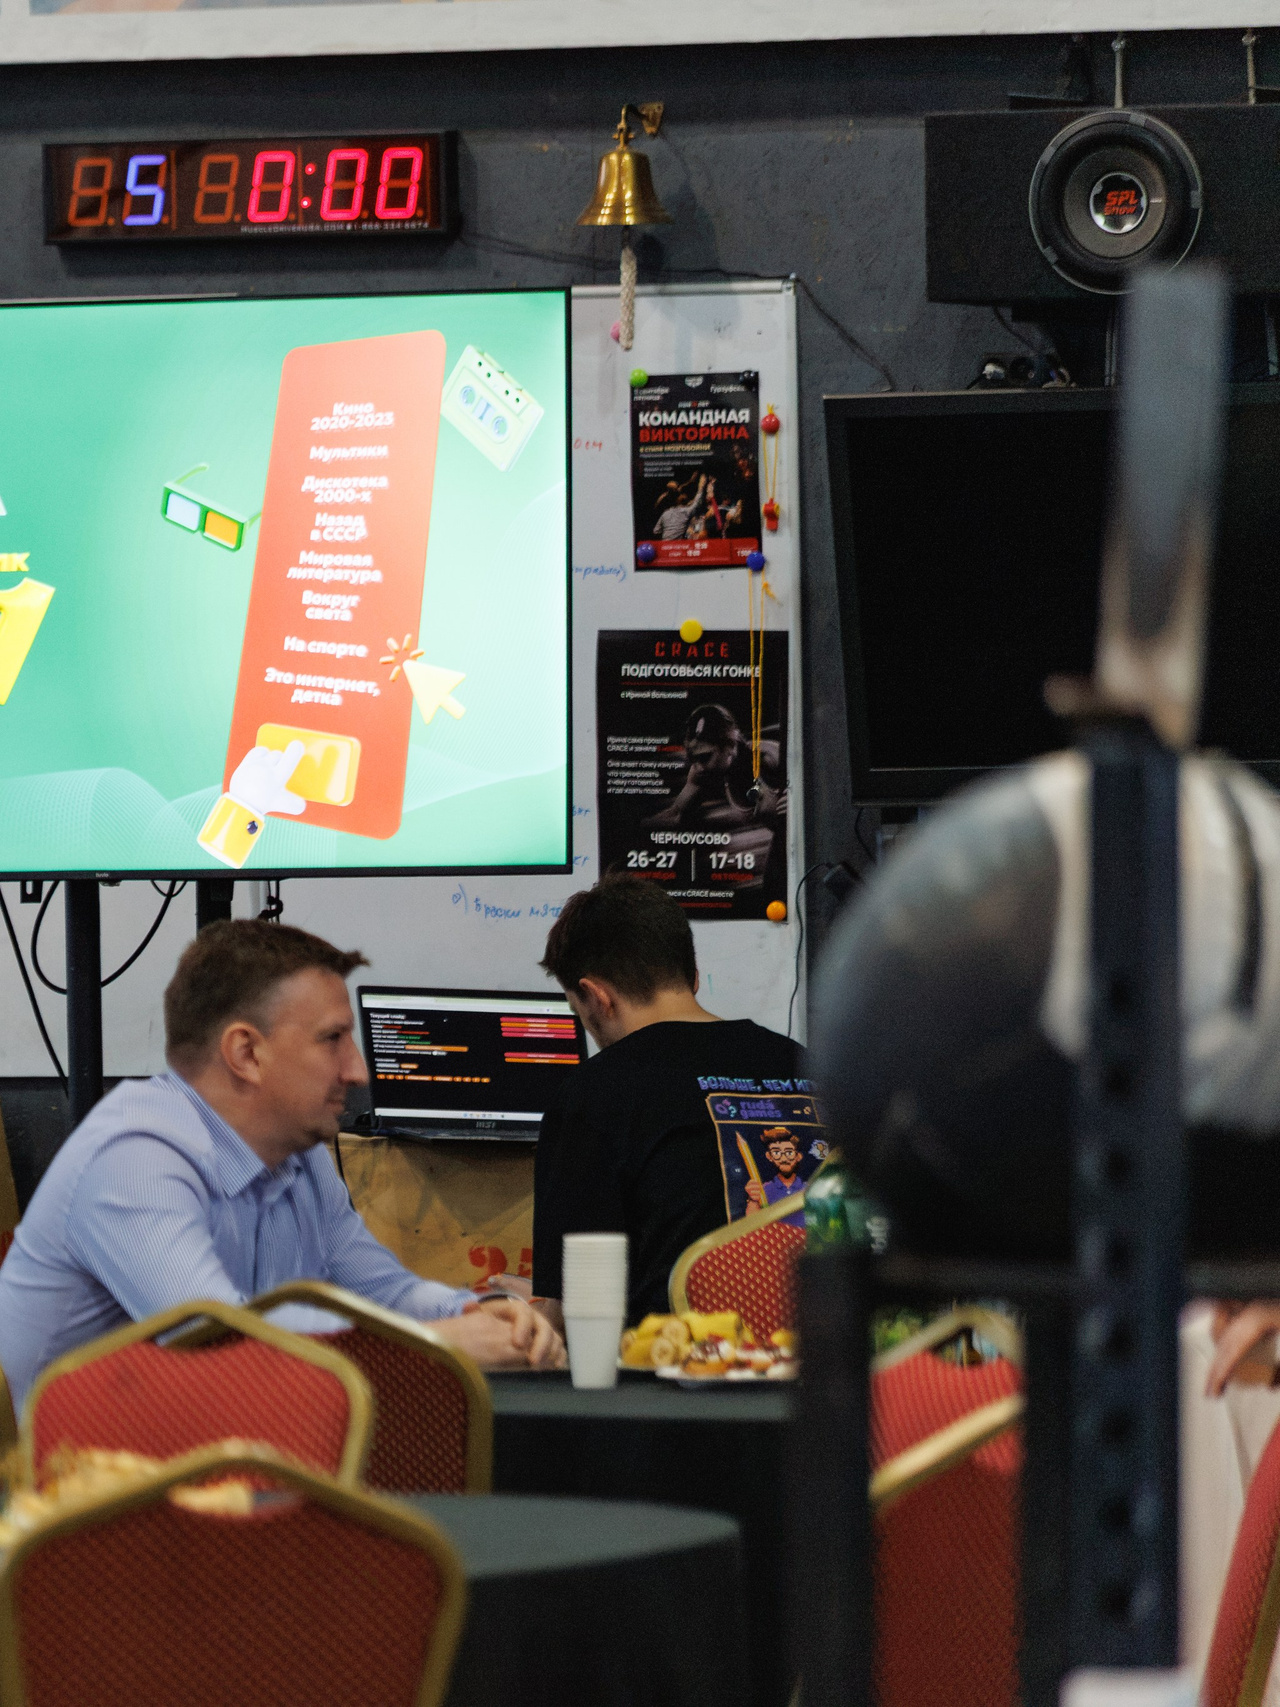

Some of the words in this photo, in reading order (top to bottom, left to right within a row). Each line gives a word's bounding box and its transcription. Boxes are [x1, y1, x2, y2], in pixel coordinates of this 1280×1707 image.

[333, 402, 375, 416] Кино
[638, 408, 750, 427] КОМАНДНАЯ
[310, 412, 395, 431] 2020-2023
[638, 426, 750, 443] ВИКТОРИНА
[309, 445, 389, 462] Мультики
[301, 475, 389, 492] Дискотека
[313, 489, 372, 504] 2000-х
[315, 512, 367, 529] Назад
[310, 529, 321, 541] в
[322, 527, 368, 542] СССР
[299, 551, 374, 568] Мировая
[287, 567, 383, 584] литература
[301, 590, 361, 609] Вокруг
[305, 608, 353, 622] света
[284, 636, 306, 652] На
[307, 640, 368, 658] спорте
[620, 663, 712, 679] ПОДГОТОВЬСЯ
[264, 667, 294, 685] Это
[295, 674, 381, 697] интернет,
[291, 688, 343, 706] детка
[650, 831, 731, 845] ЧЕРНОУСОВО
[626, 850, 679, 869] 26-27
[708, 851, 756, 870] 17-18
[697, 1076, 762, 1092] БОЛЬШЕ,
[762, 1078, 793, 1092] ЧЕМ
[740, 1108, 783, 1120] games
